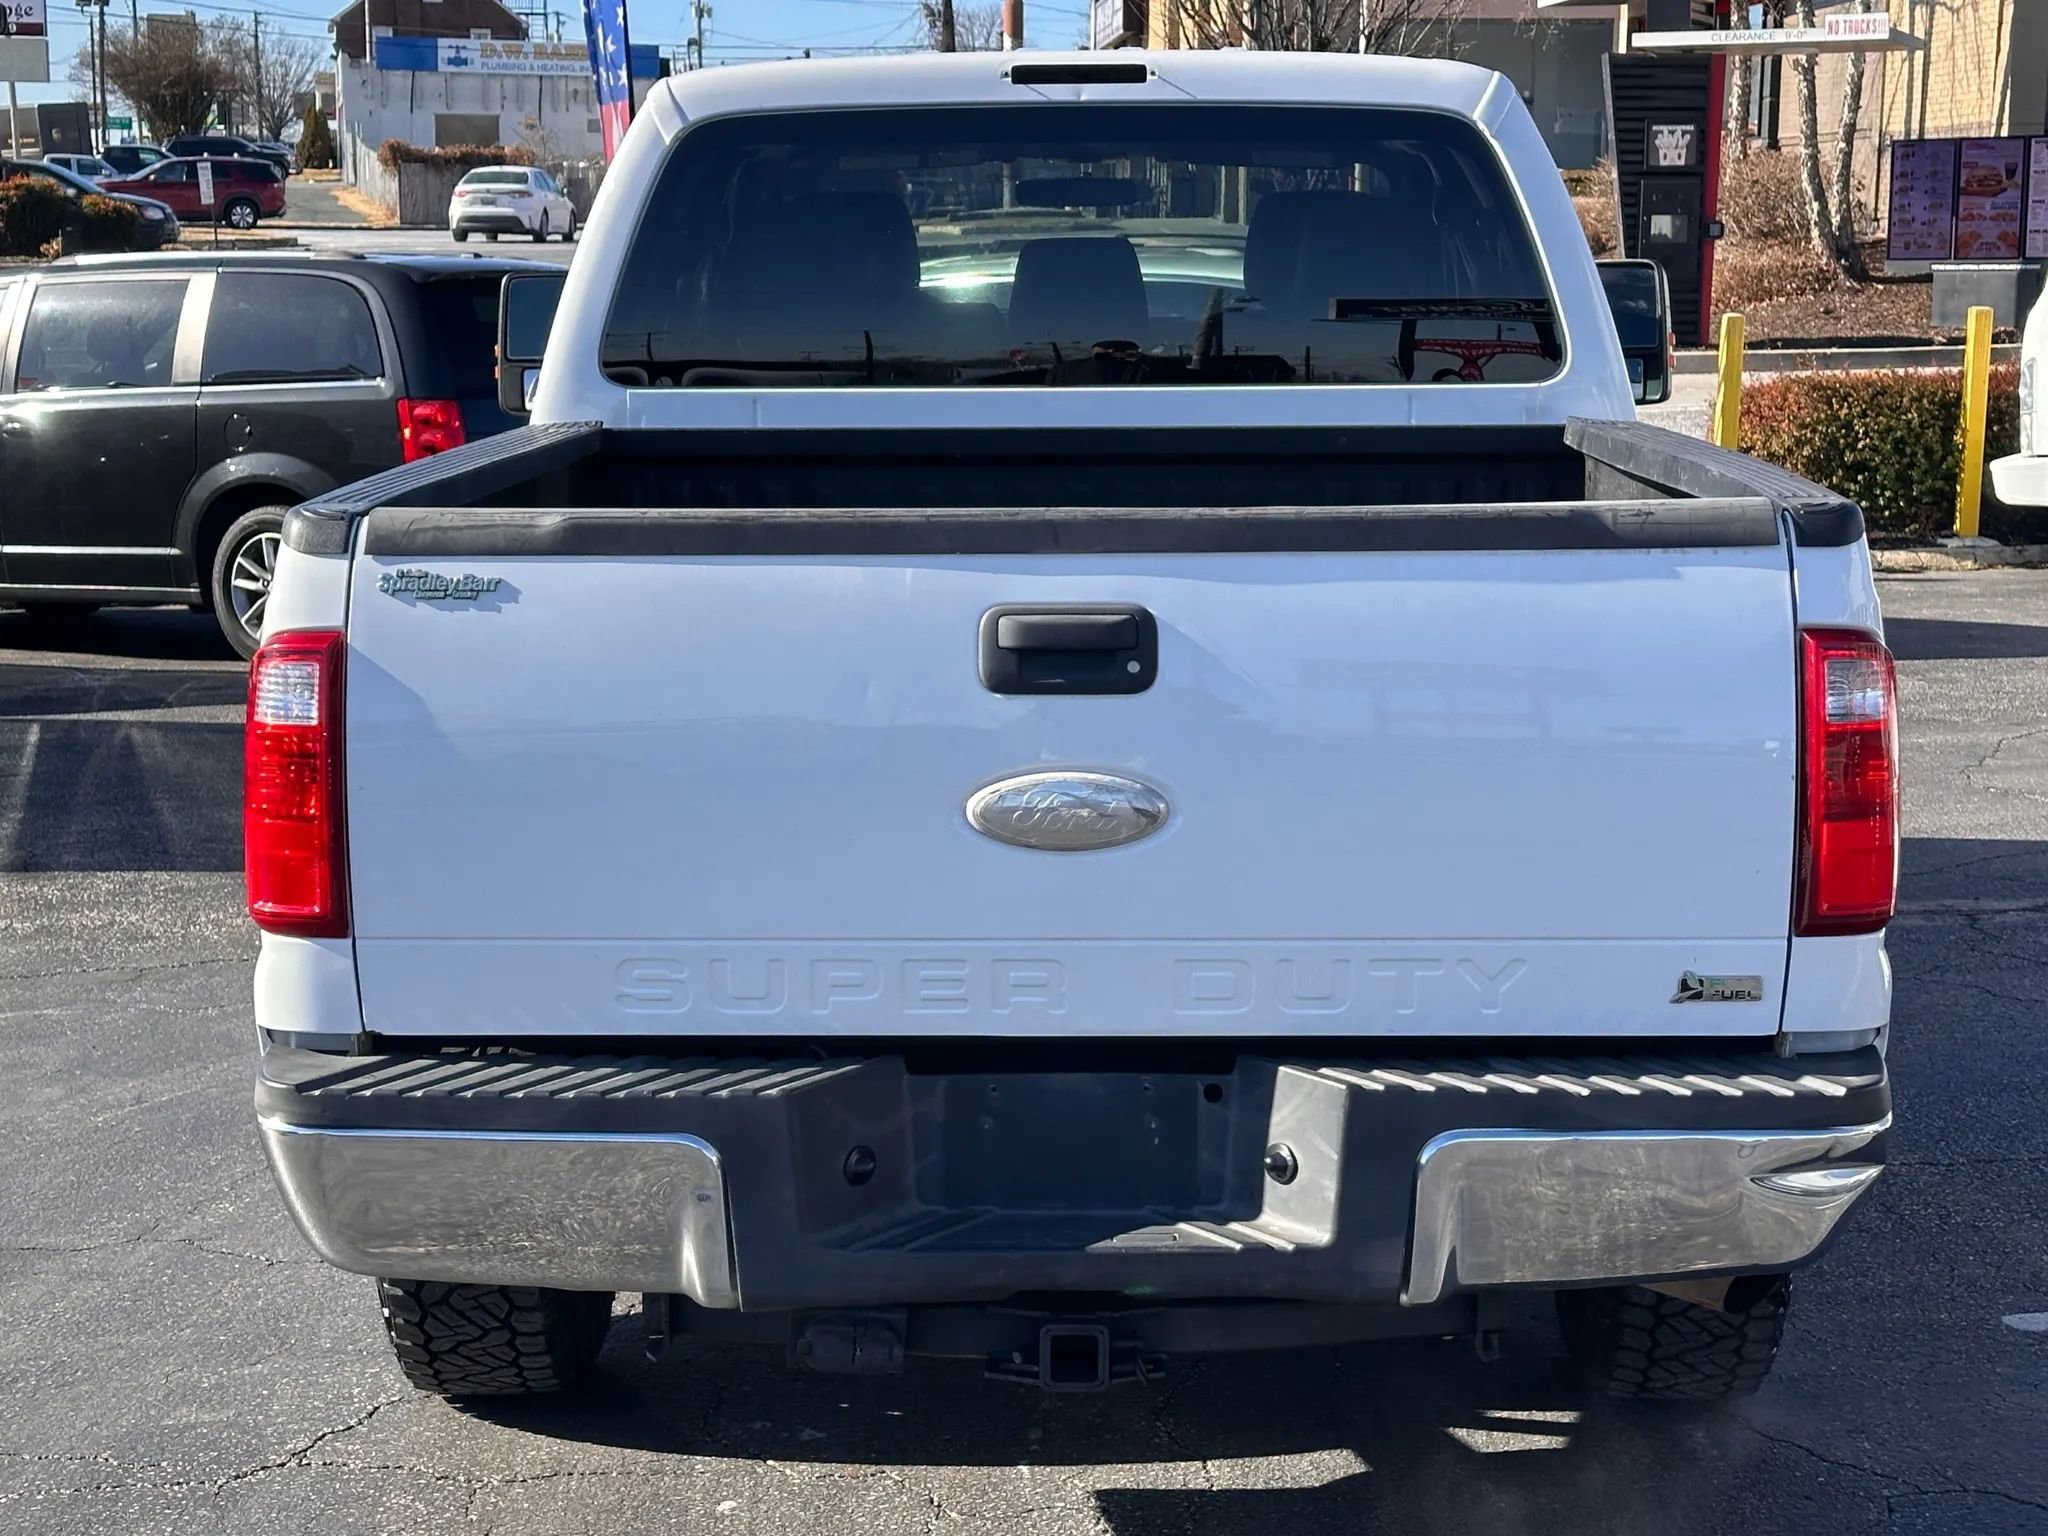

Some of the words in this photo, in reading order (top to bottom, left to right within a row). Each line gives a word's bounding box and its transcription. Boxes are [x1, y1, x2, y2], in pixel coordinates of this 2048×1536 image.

[1827, 19, 1839, 36] NO
[1711, 31, 1776, 42] CLEARANCE
[481, 62, 527, 71] PLUMBING
[377, 572, 460, 596] Spradley
[459, 573, 500, 592] Barr
[1011, 782, 1119, 832] Ford
[615, 957, 1068, 1015] SUPER
[1173, 957, 1528, 1015] DUTY
[1712, 990, 1758, 1000] FUEL
